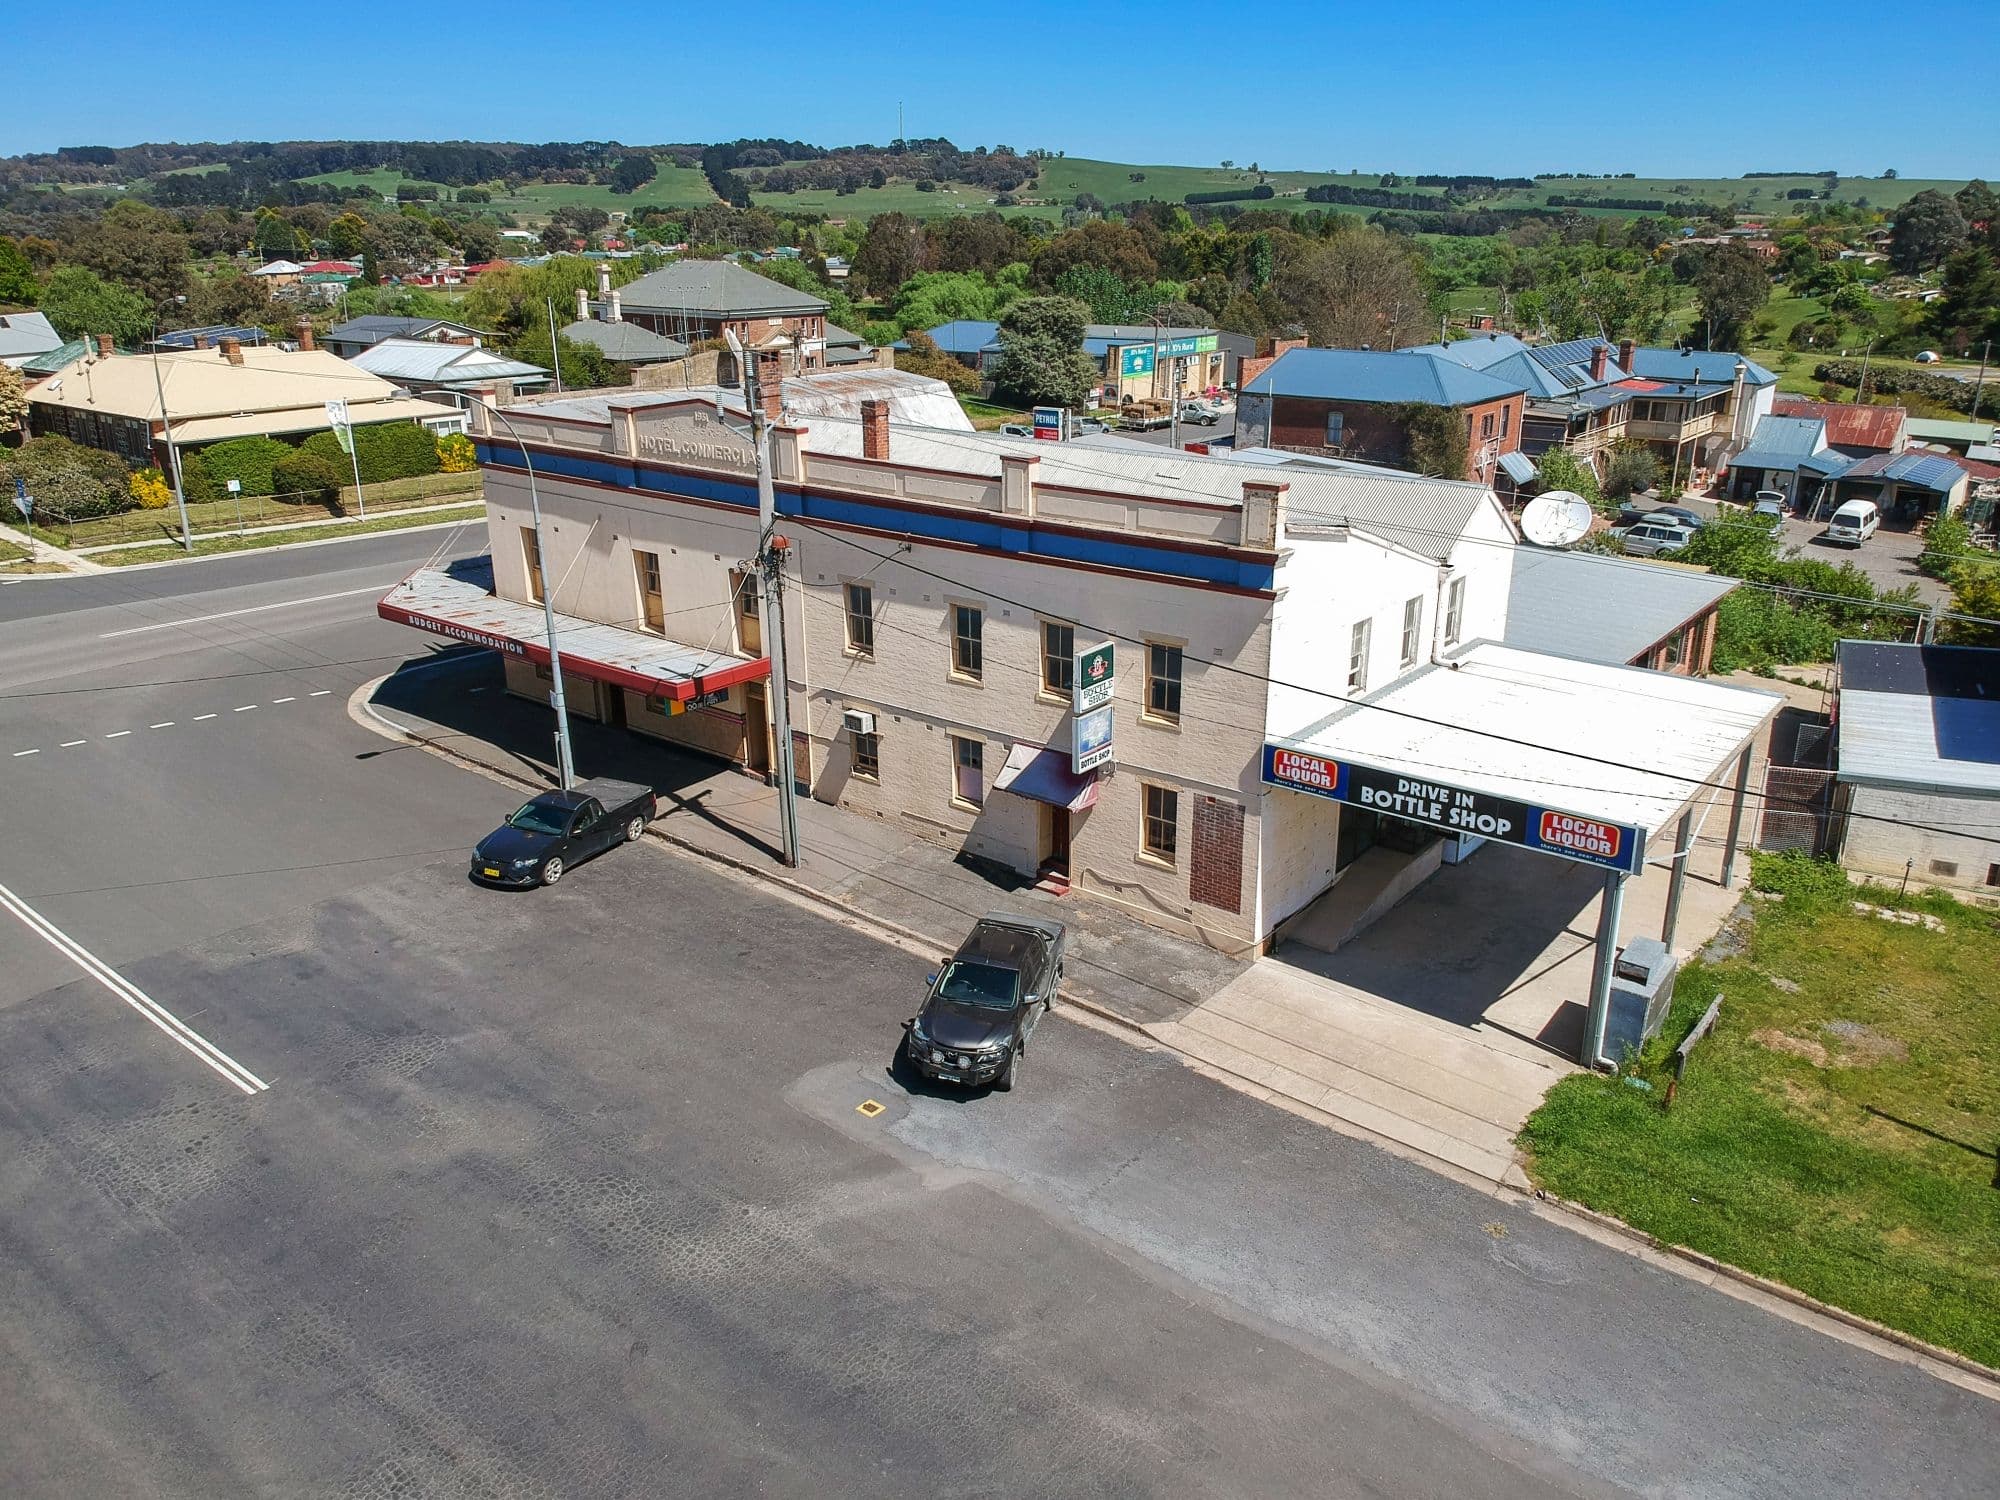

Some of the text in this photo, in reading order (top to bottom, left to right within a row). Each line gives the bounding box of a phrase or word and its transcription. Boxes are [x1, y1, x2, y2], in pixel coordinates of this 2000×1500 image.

[1035, 413, 1057, 425] PETROL
[640, 434, 758, 465] HOTEL COMMERCIA
[408, 615, 523, 655] BUDGET ACCOMMODATION
[1083, 680, 1113, 699] BOTTLE
[1088, 691, 1109, 706] SHOP
[1081, 749, 1110, 769] BOTTLE SHOP
[1283, 753, 1328, 774] LOCAL
[1398, 778, 1475, 809] DRIVE IN
[1361, 786, 1512, 836] BOTTLE SHOP
[1552, 815, 1608, 840] LOCAL
